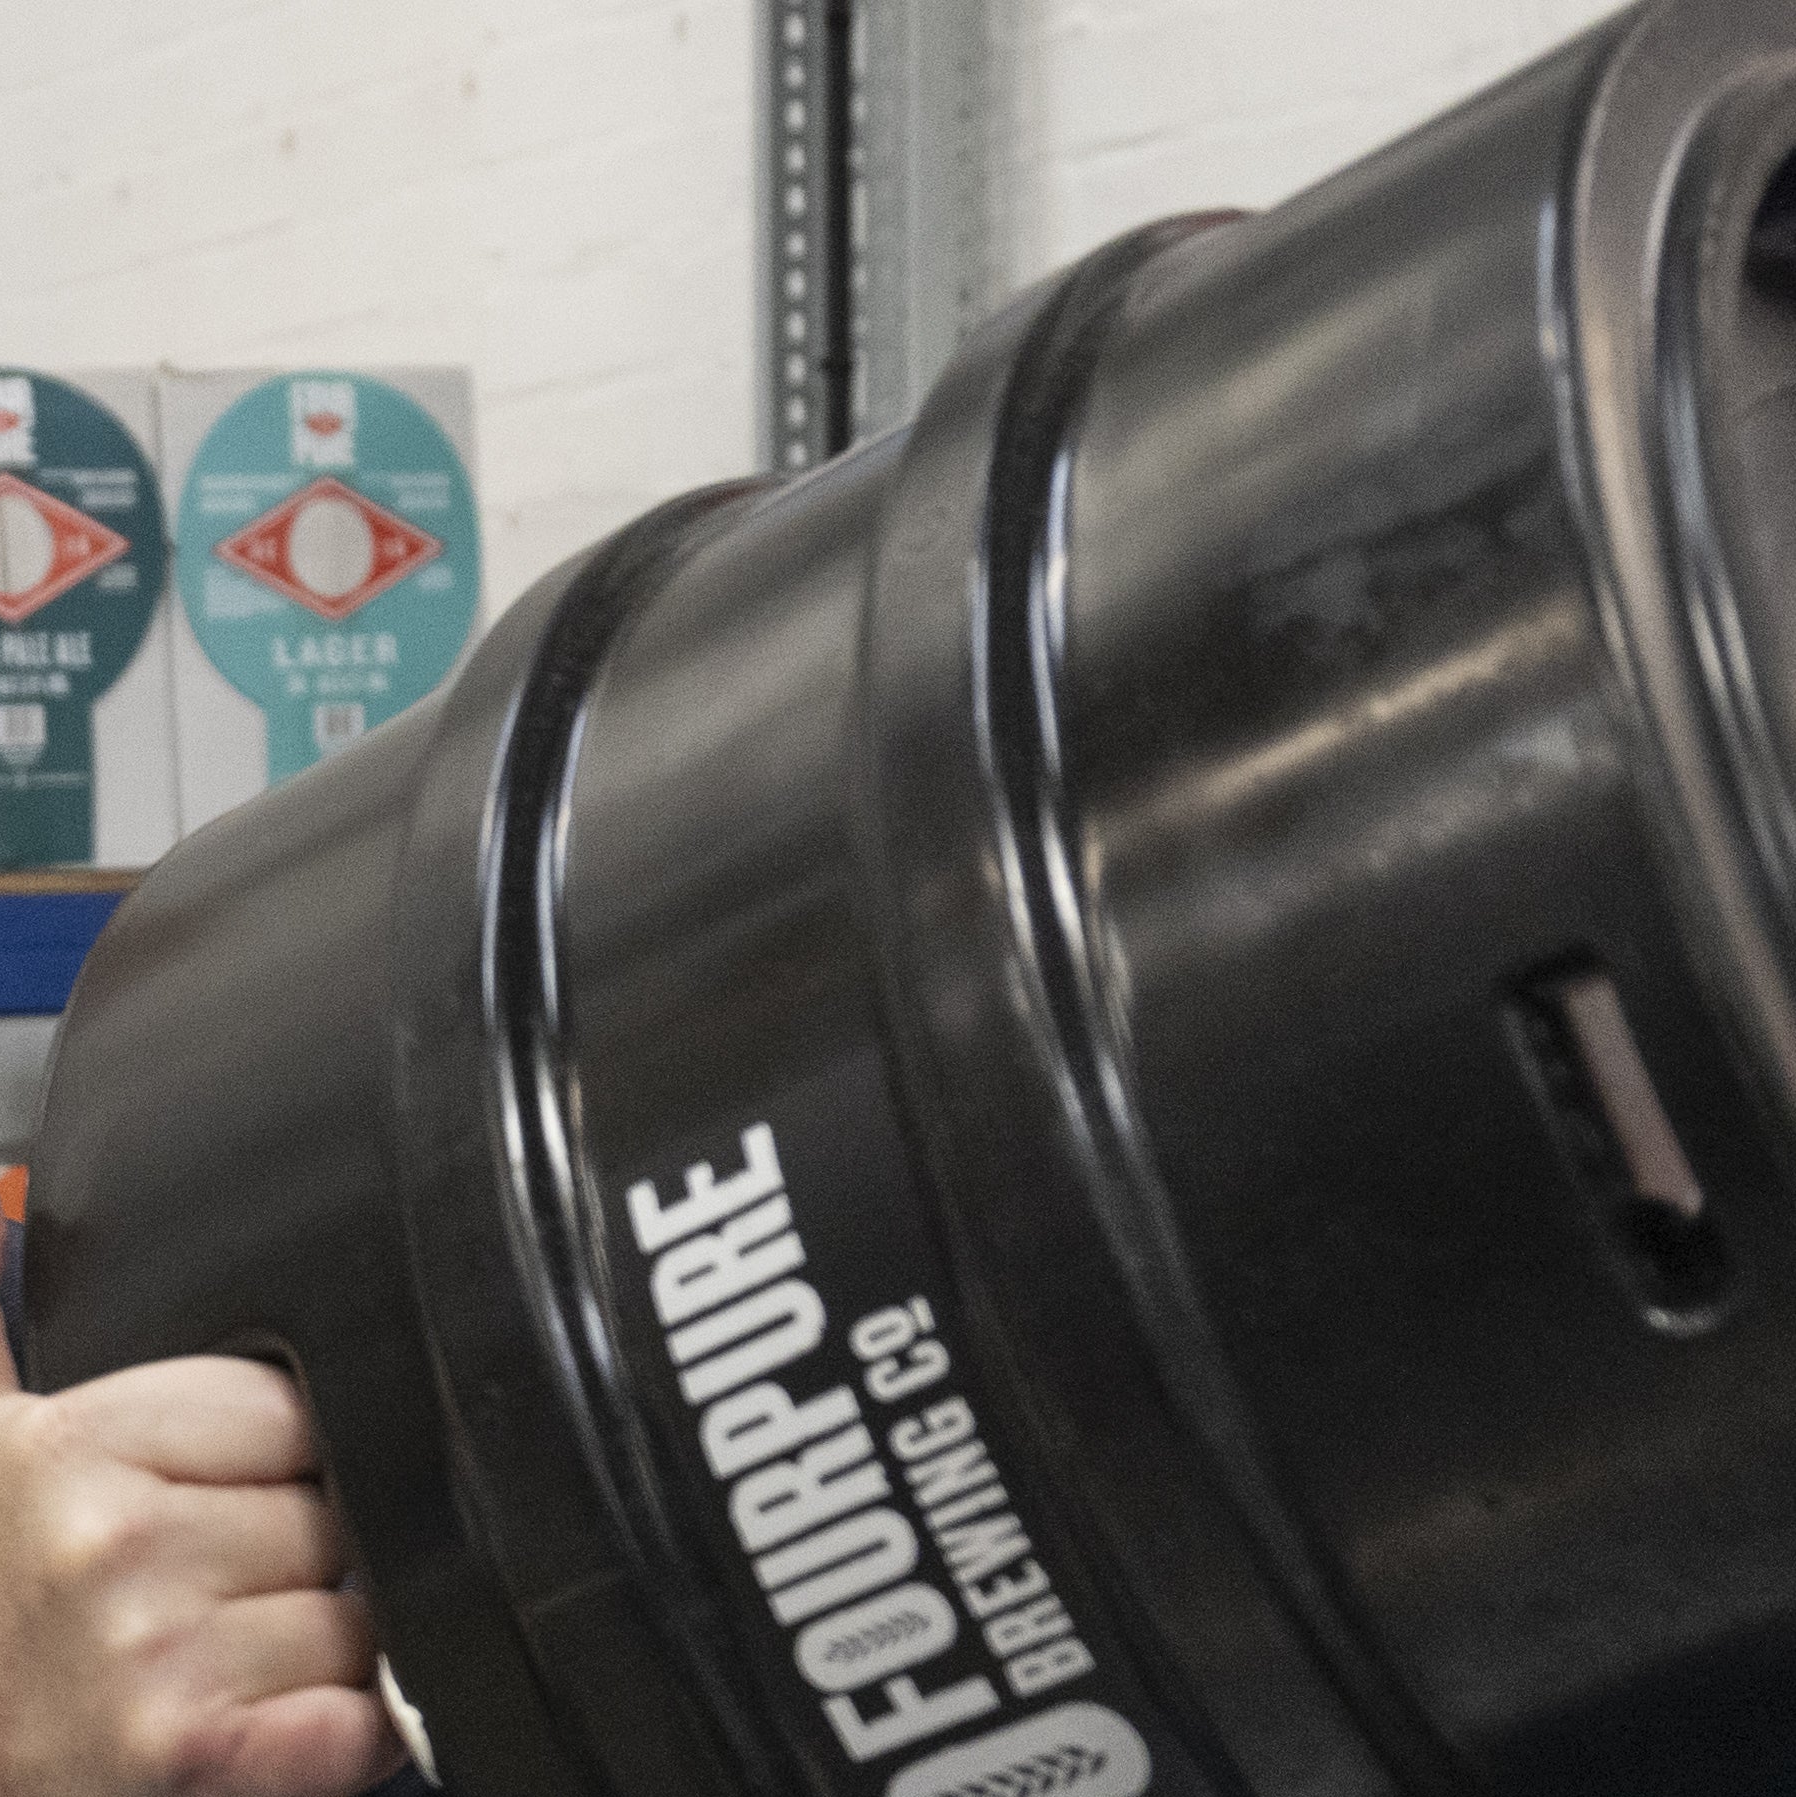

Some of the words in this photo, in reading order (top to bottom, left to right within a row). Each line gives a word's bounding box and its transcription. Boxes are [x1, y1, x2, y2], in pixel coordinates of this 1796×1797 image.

[271, 633, 399, 667] LAGER
[625, 1122, 1001, 1763] FOURPURE
[888, 1395, 1097, 1699] BREWING
